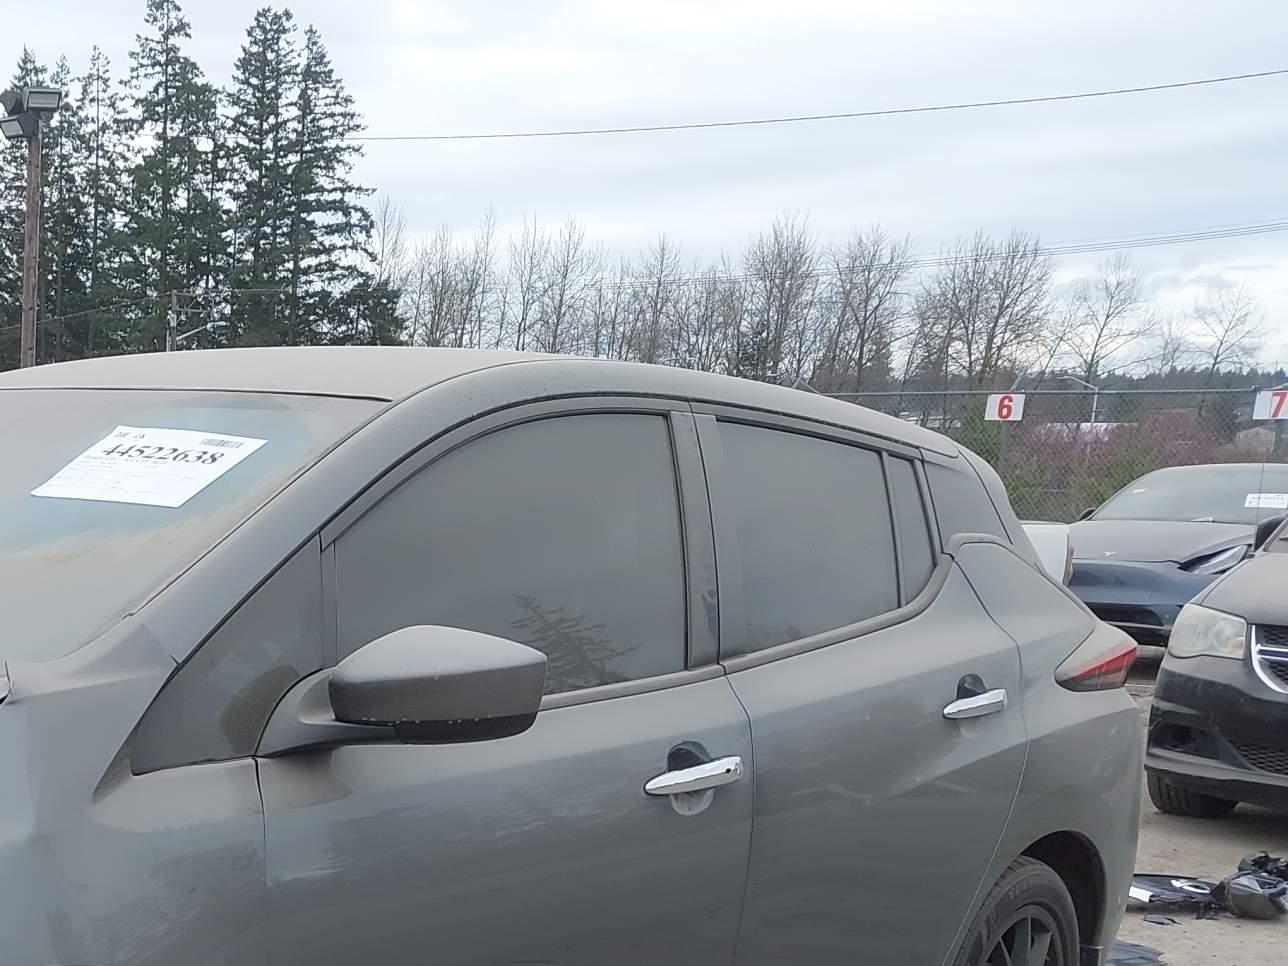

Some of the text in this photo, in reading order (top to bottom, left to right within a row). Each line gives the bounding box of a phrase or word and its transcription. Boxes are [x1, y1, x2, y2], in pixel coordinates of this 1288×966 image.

[997, 395, 1014, 420] 6
[1271, 391, 1288, 419] 7
[102, 443, 225, 465] 44522638
